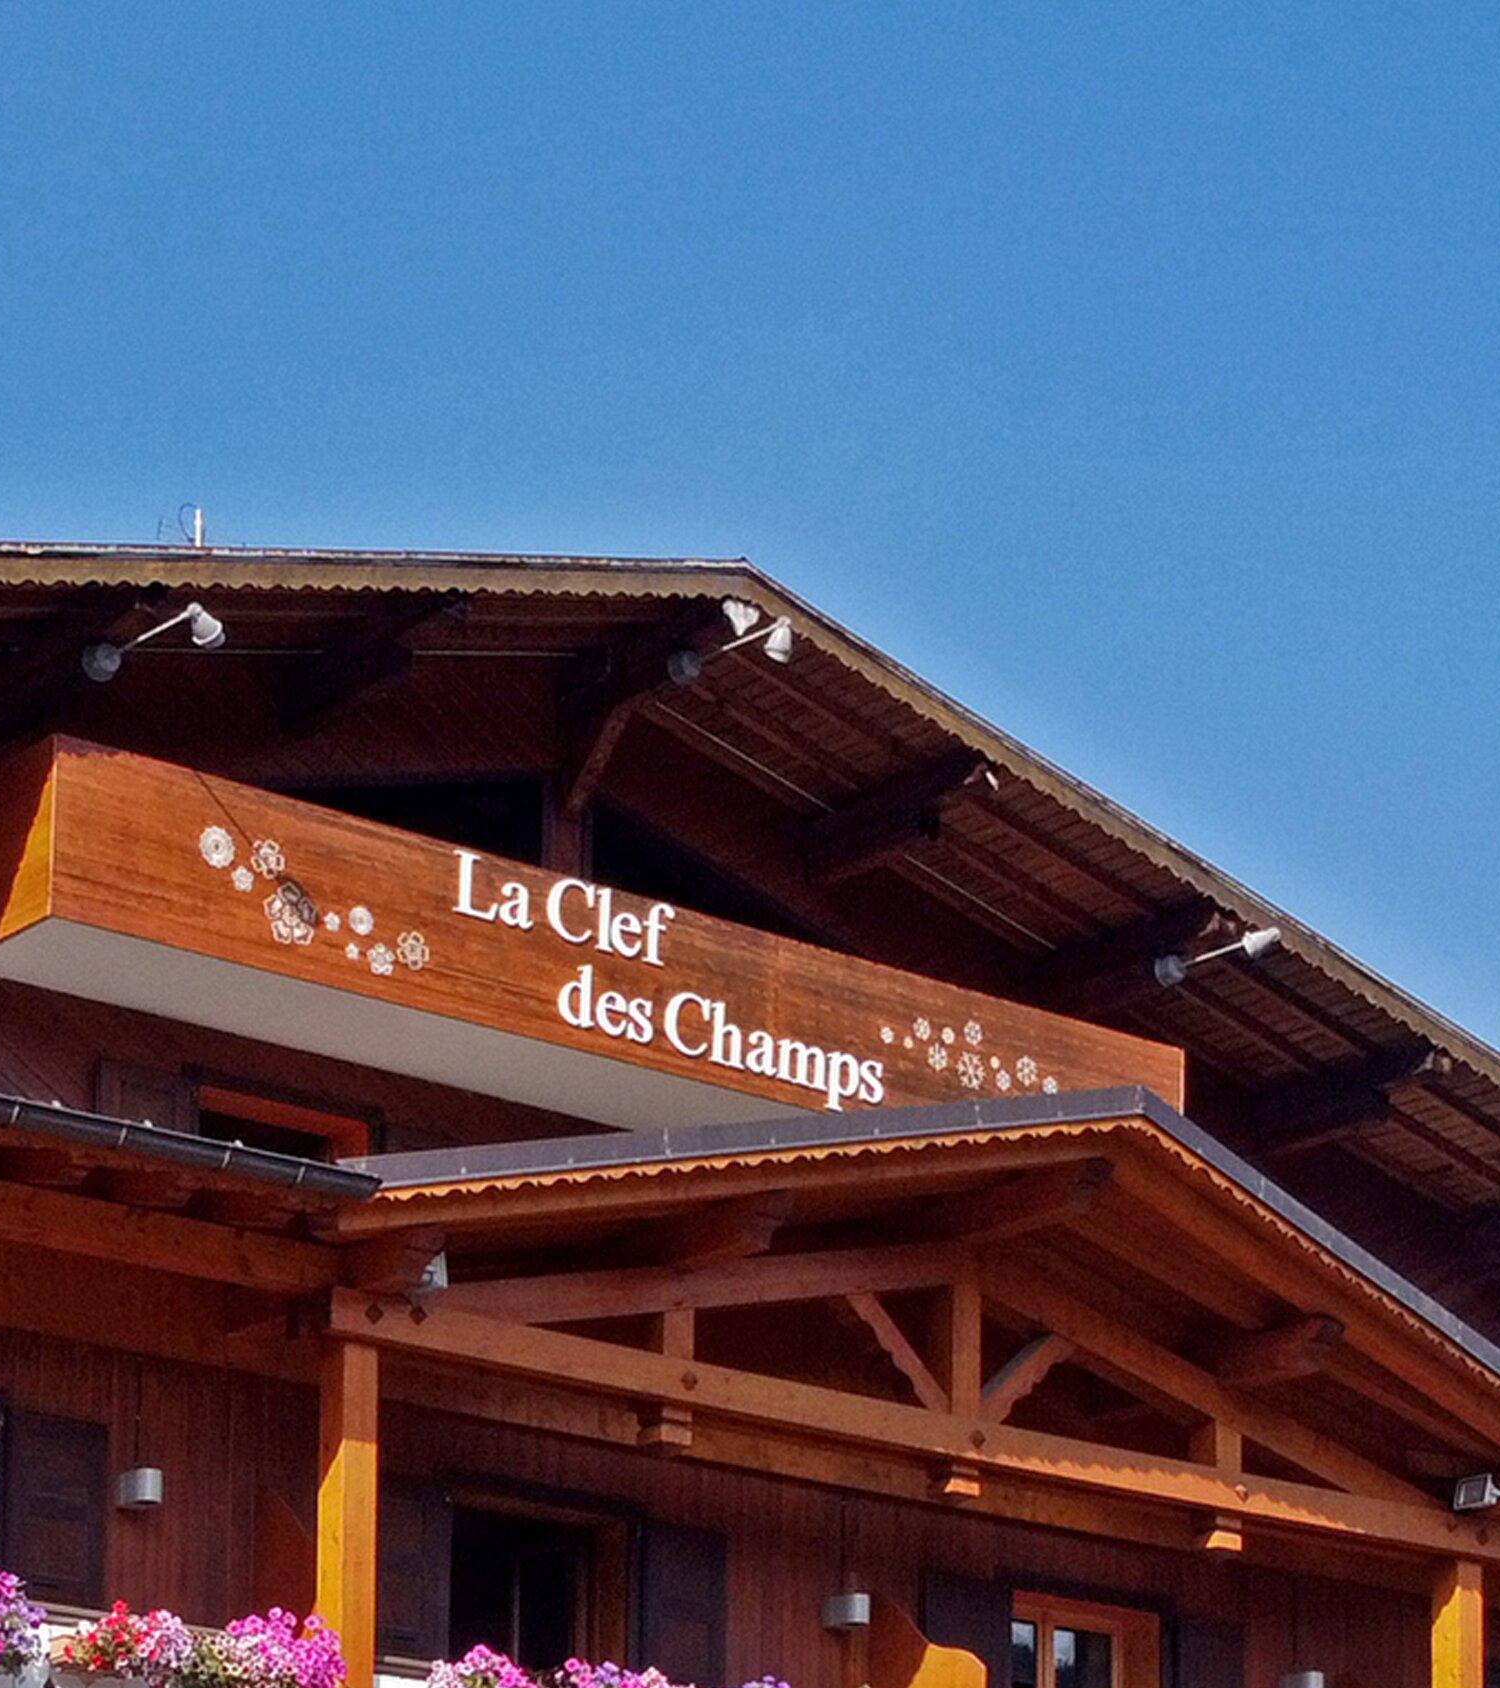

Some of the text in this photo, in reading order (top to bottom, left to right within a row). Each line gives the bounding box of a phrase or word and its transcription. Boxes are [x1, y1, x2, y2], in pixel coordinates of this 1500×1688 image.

[453, 849, 675, 967] La Clef
[557, 965, 883, 1111] des Champs
